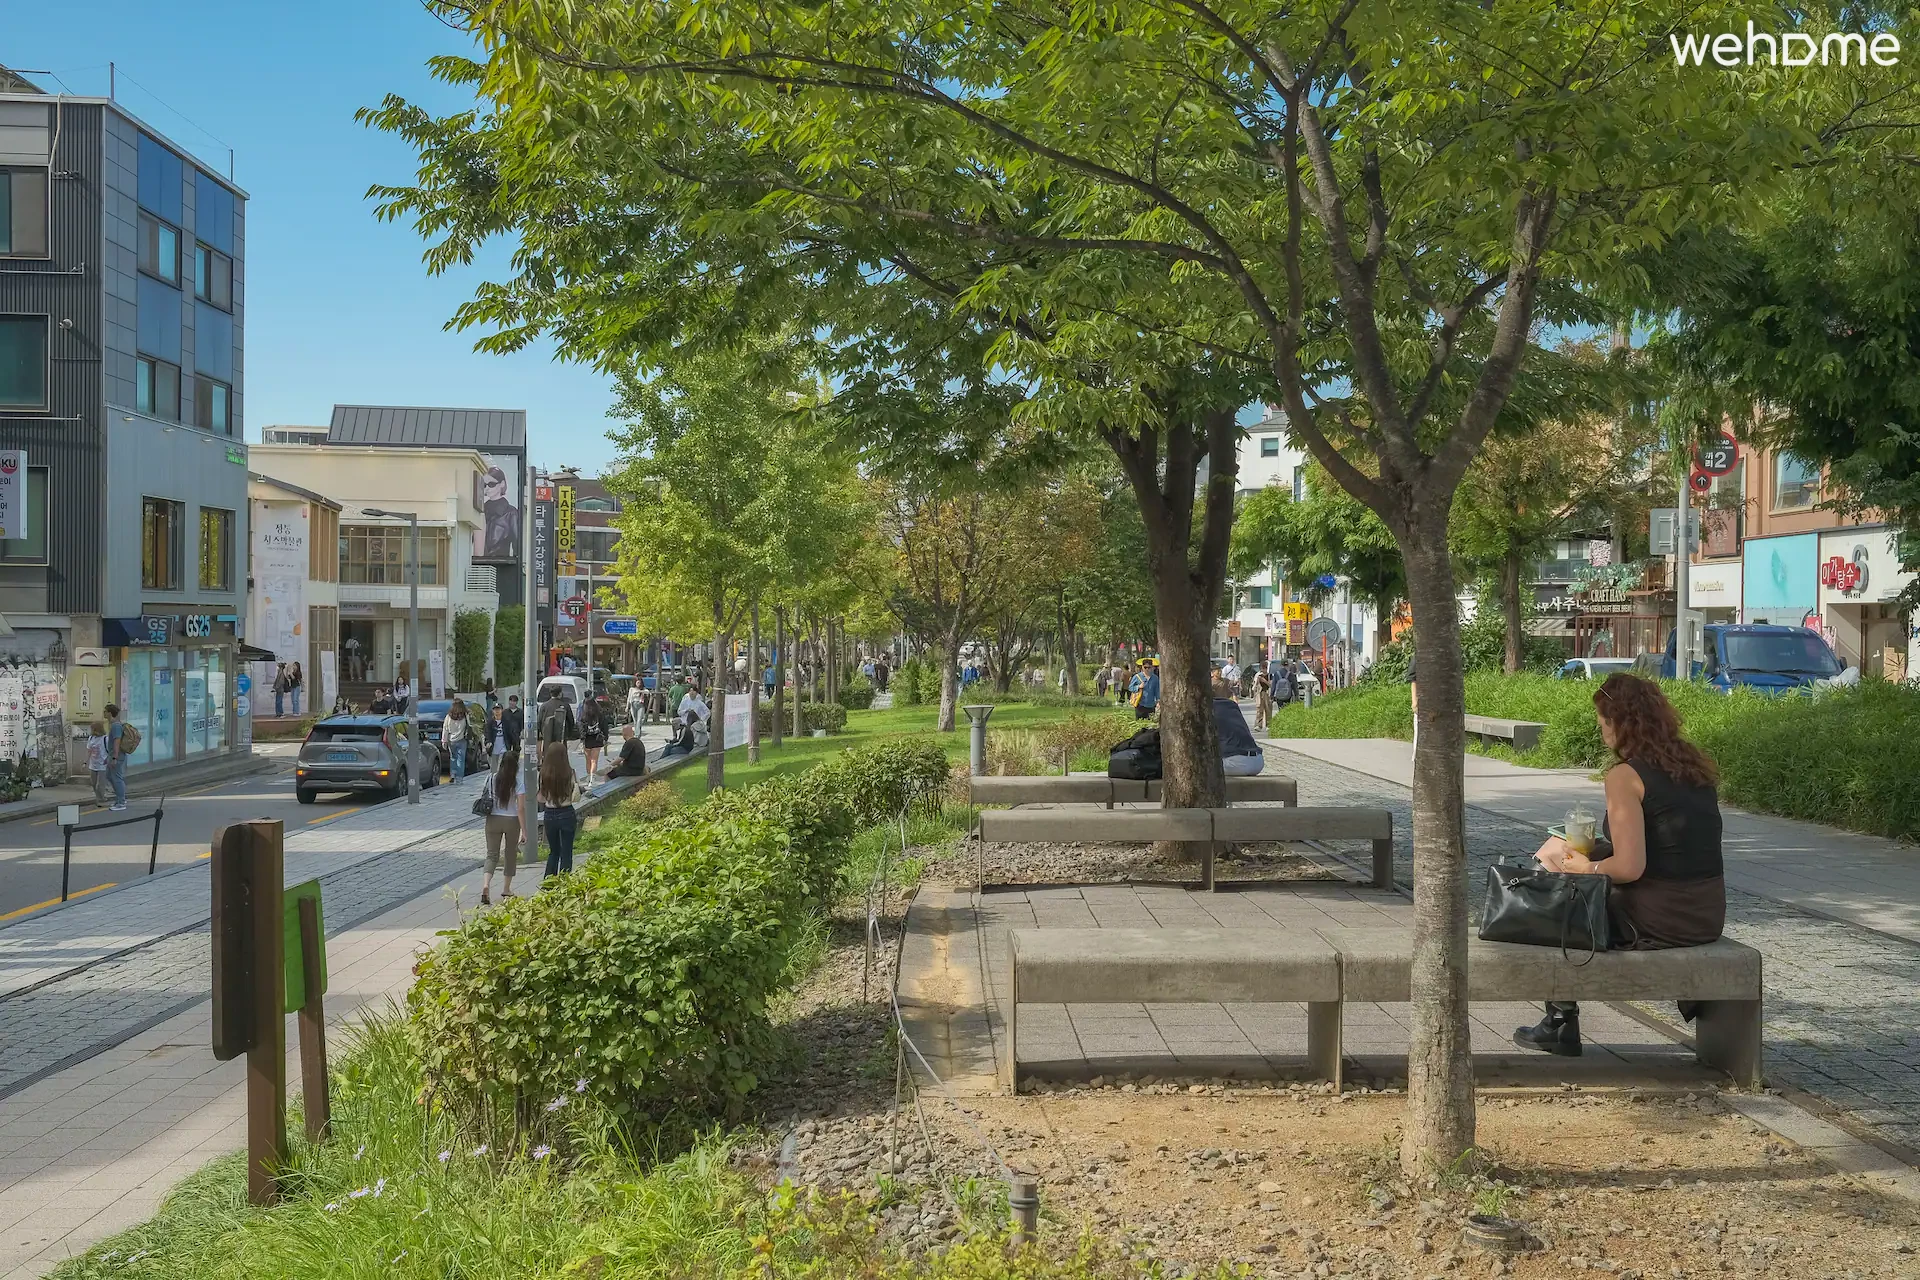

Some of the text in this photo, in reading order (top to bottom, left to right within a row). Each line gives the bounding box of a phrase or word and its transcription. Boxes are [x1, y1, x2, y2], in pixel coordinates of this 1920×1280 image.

[1714, 451, 1726, 468] 2
[560, 490, 570, 547] TATTOO
[1591, 589, 1609, 603] CRAFT
[147, 618, 168, 631] GS
[186, 614, 211, 638] GS25
[148, 631, 167, 644] 25
[38, 702, 58, 711] OPEN!
